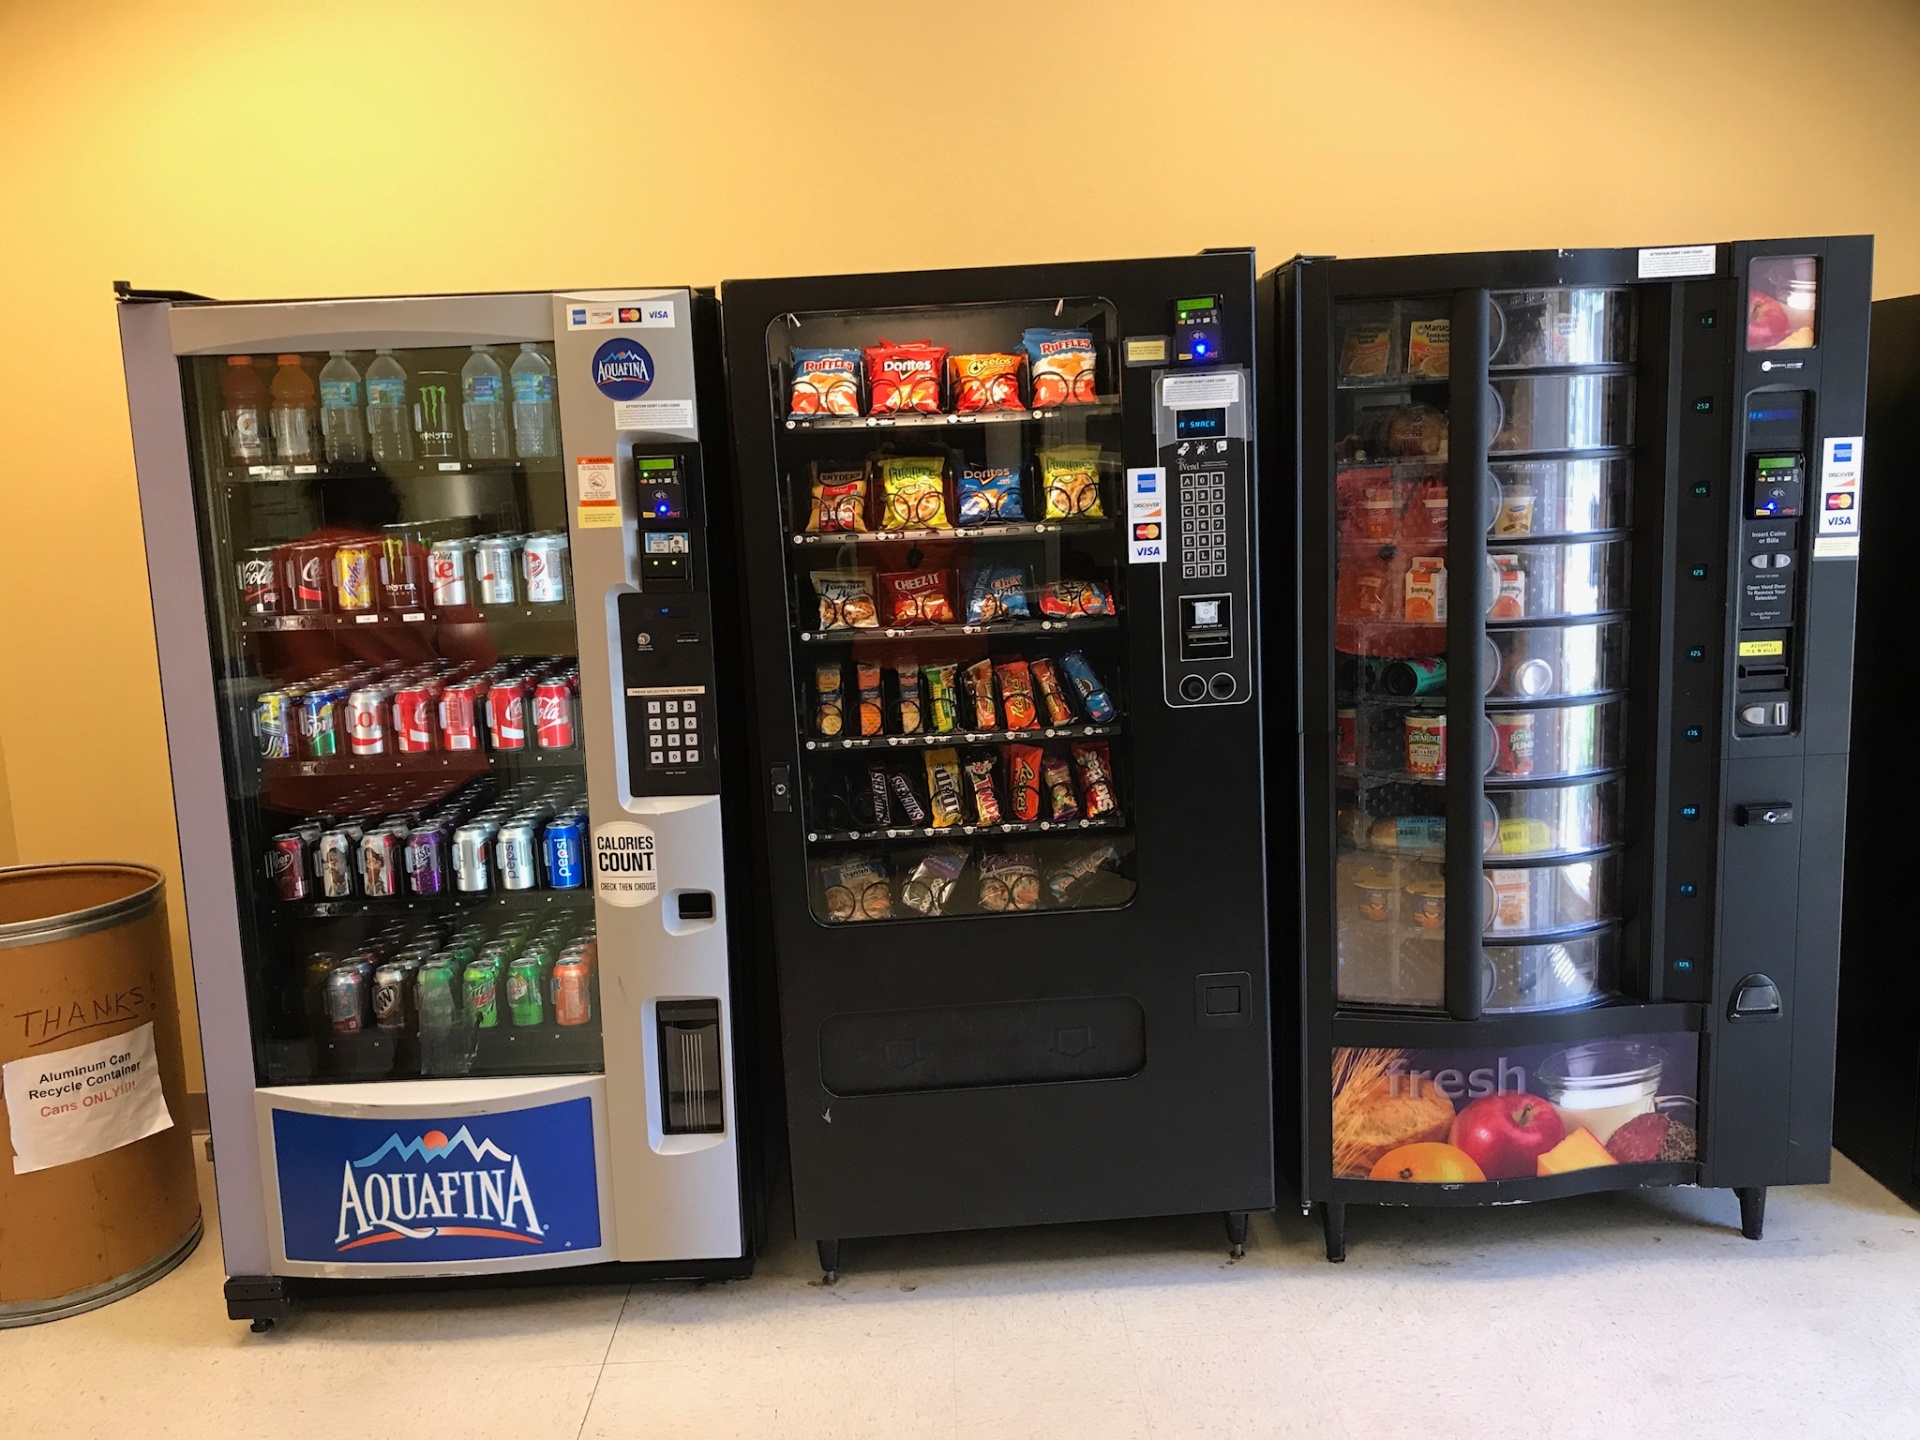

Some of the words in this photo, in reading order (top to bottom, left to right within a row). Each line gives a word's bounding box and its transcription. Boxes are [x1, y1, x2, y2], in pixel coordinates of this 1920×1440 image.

[649, 310, 669, 319] VISA
[1040, 338, 1092, 355] RUFFLES
[597, 358, 650, 384] AQUAFINA
[803, 358, 855, 373] RUFFLES
[884, 360, 932, 372] Doritos
[967, 357, 1014, 376] Cheetos
[1190, 420, 1216, 428] SNACK
[963, 467, 1010, 479] Doritos
[1828, 516, 1852, 525] VISA
[1137, 546, 1160, 556] VISA
[990, 574, 1023, 589] Chex
[597, 836, 654, 850] CALORIES
[553, 838, 571, 877] pepsi
[598, 852, 654, 871] COUNT
[600, 882, 617, 891] CHECK
[619, 882, 633, 891] THEN
[634, 881, 656, 891] CHOOSE
[14, 972, 157, 1038] THANKS!
[39, 1060, 106, 1085] Aluminum
[109, 1052, 131, 1066] Can
[29, 1081, 82, 1100] Recycle
[86, 1061, 142, 1087] Container
[1385, 1057, 1526, 1098] fresh
[40, 1102, 79, 1118] Cans
[335, 1154, 545, 1244] AQUAFINA
